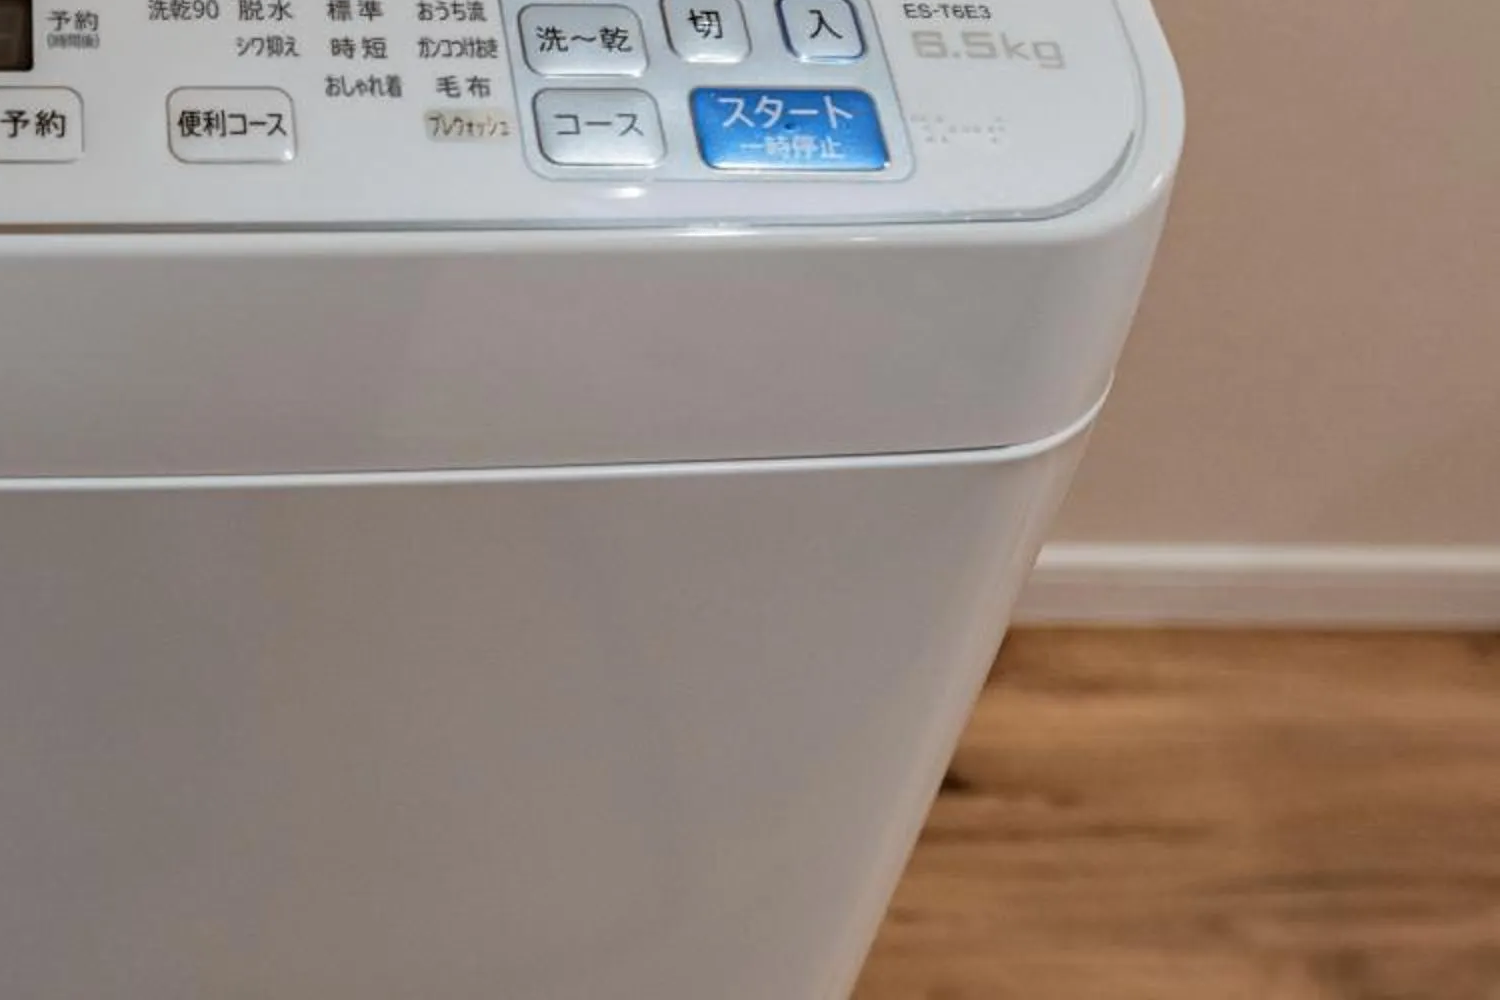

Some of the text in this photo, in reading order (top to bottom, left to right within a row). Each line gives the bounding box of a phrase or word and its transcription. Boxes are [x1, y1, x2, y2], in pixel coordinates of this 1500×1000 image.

[47, 10, 99, 32] 予約
[416, 0, 488, 22] おうち流
[687, 7, 723, 40] 切
[902, 2, 992, 20] ES-T6E3
[808, 8, 844, 40] 入
[236, 34, 301, 58] シワ抑え
[329, 36, 388, 60] 時短
[910, 29, 1066, 70] 6.5kg
[324, 74, 403, 98] おしゃれ着
[435, 74, 491, 99] 毛布
[0, 109, 67, 139] 予約
[176, 109, 287, 138] 便利コース
[552, 112, 644, 137] コース
[717, 95, 854, 129] スタート
[739, 136, 846, 161] 一時停止
